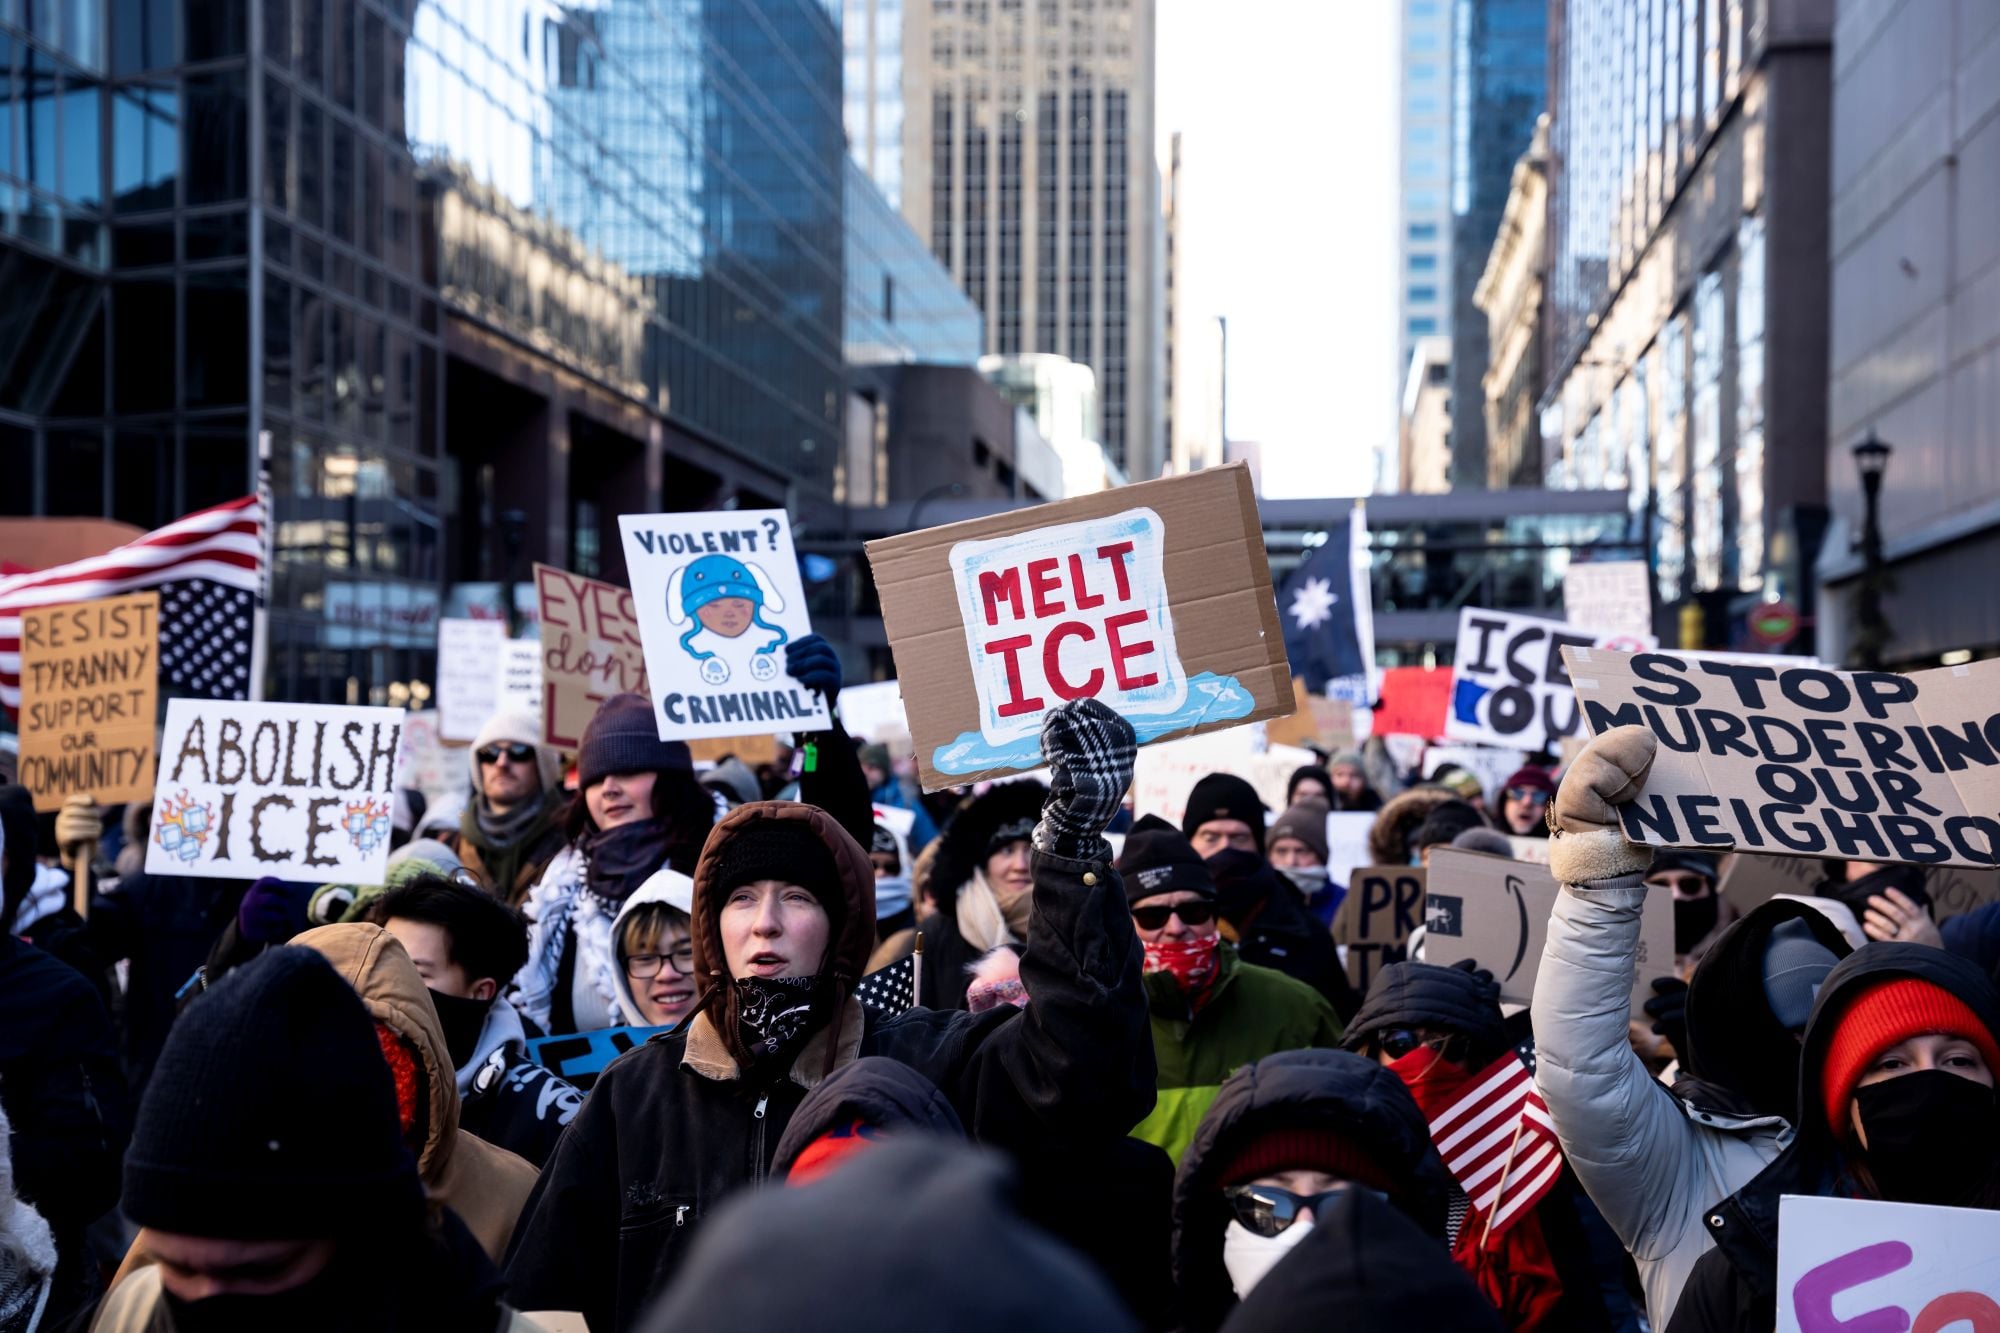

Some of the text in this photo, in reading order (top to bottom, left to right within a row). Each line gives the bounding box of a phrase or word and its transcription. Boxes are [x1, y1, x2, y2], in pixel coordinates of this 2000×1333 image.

[633, 518, 780, 554] VIOLENT?
[978, 540, 1134, 626] MELT
[24, 602, 153, 651] RESIST
[1466, 617, 1597, 686] ICE
[29, 644, 149, 694] TYRANNY
[985, 608, 1159, 717] ICE
[1629, 653, 1918, 719] STOP
[28, 689, 145, 732] SUPPORT
[663, 689, 823, 724] CRIMINAL?
[60, 731, 97, 750] OUR
[169, 713, 402, 793] ABOLISH
[21, 745, 148, 796] COMMUNITY
[1755, 763, 1943, 816] OUR
[211, 792, 342, 868] ICE
[1618, 794, 2000, 865] NEIGHBO
